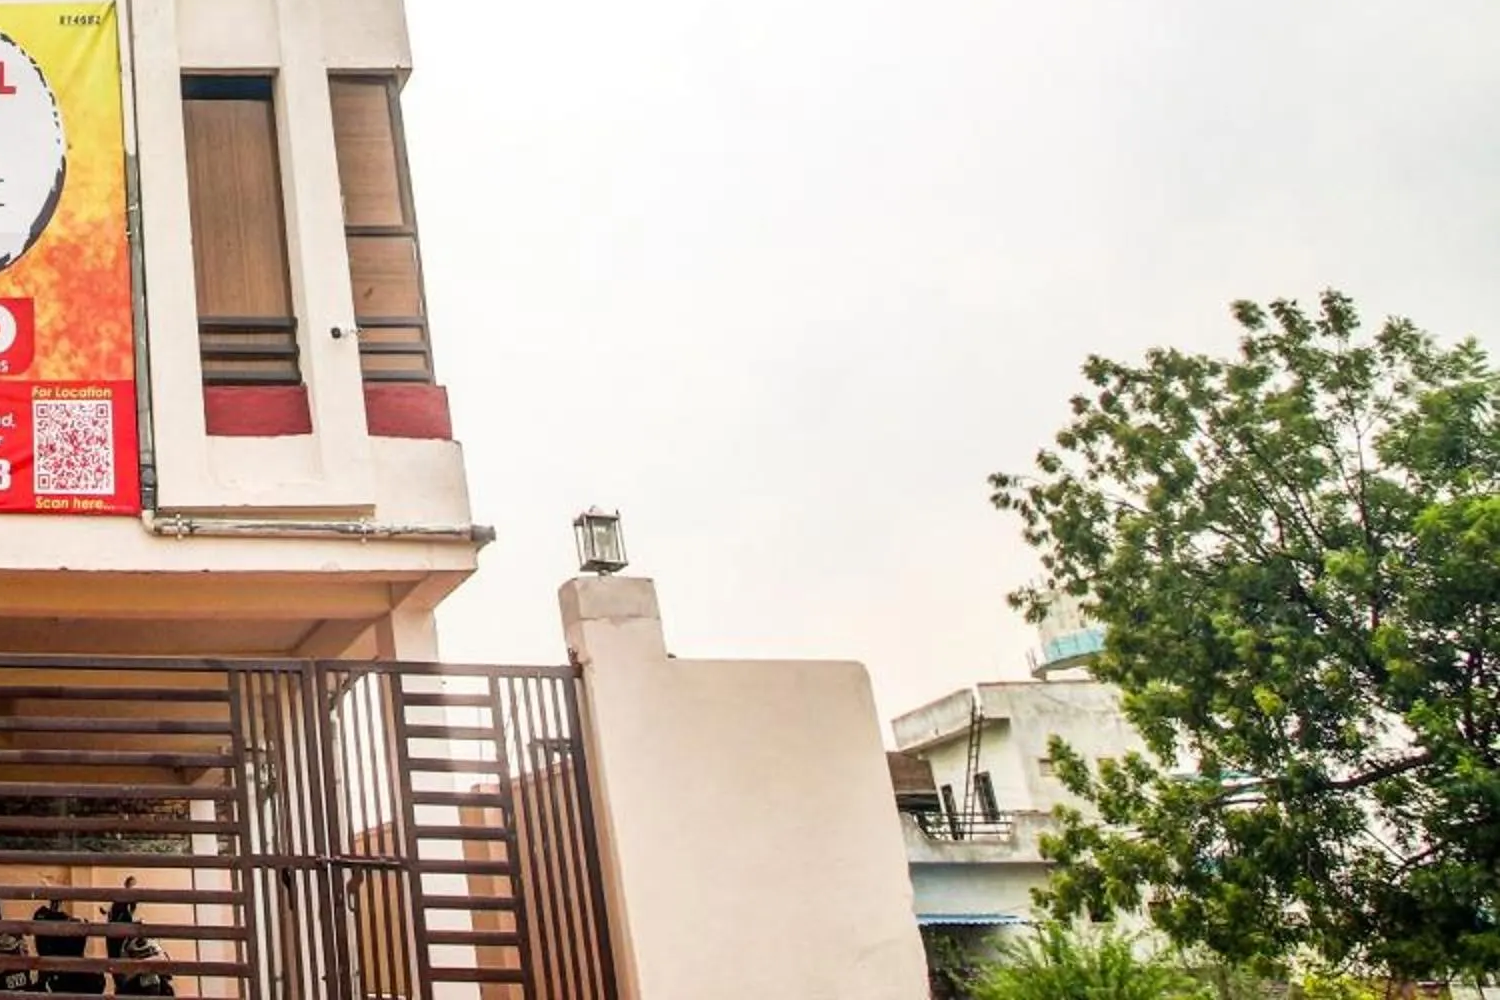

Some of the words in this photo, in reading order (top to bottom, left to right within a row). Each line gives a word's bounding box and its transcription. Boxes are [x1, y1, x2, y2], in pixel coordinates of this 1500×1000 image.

[32, 386, 52, 398] For
[55, 385, 113, 398] Location
[35, 496, 69, 509] Scan
